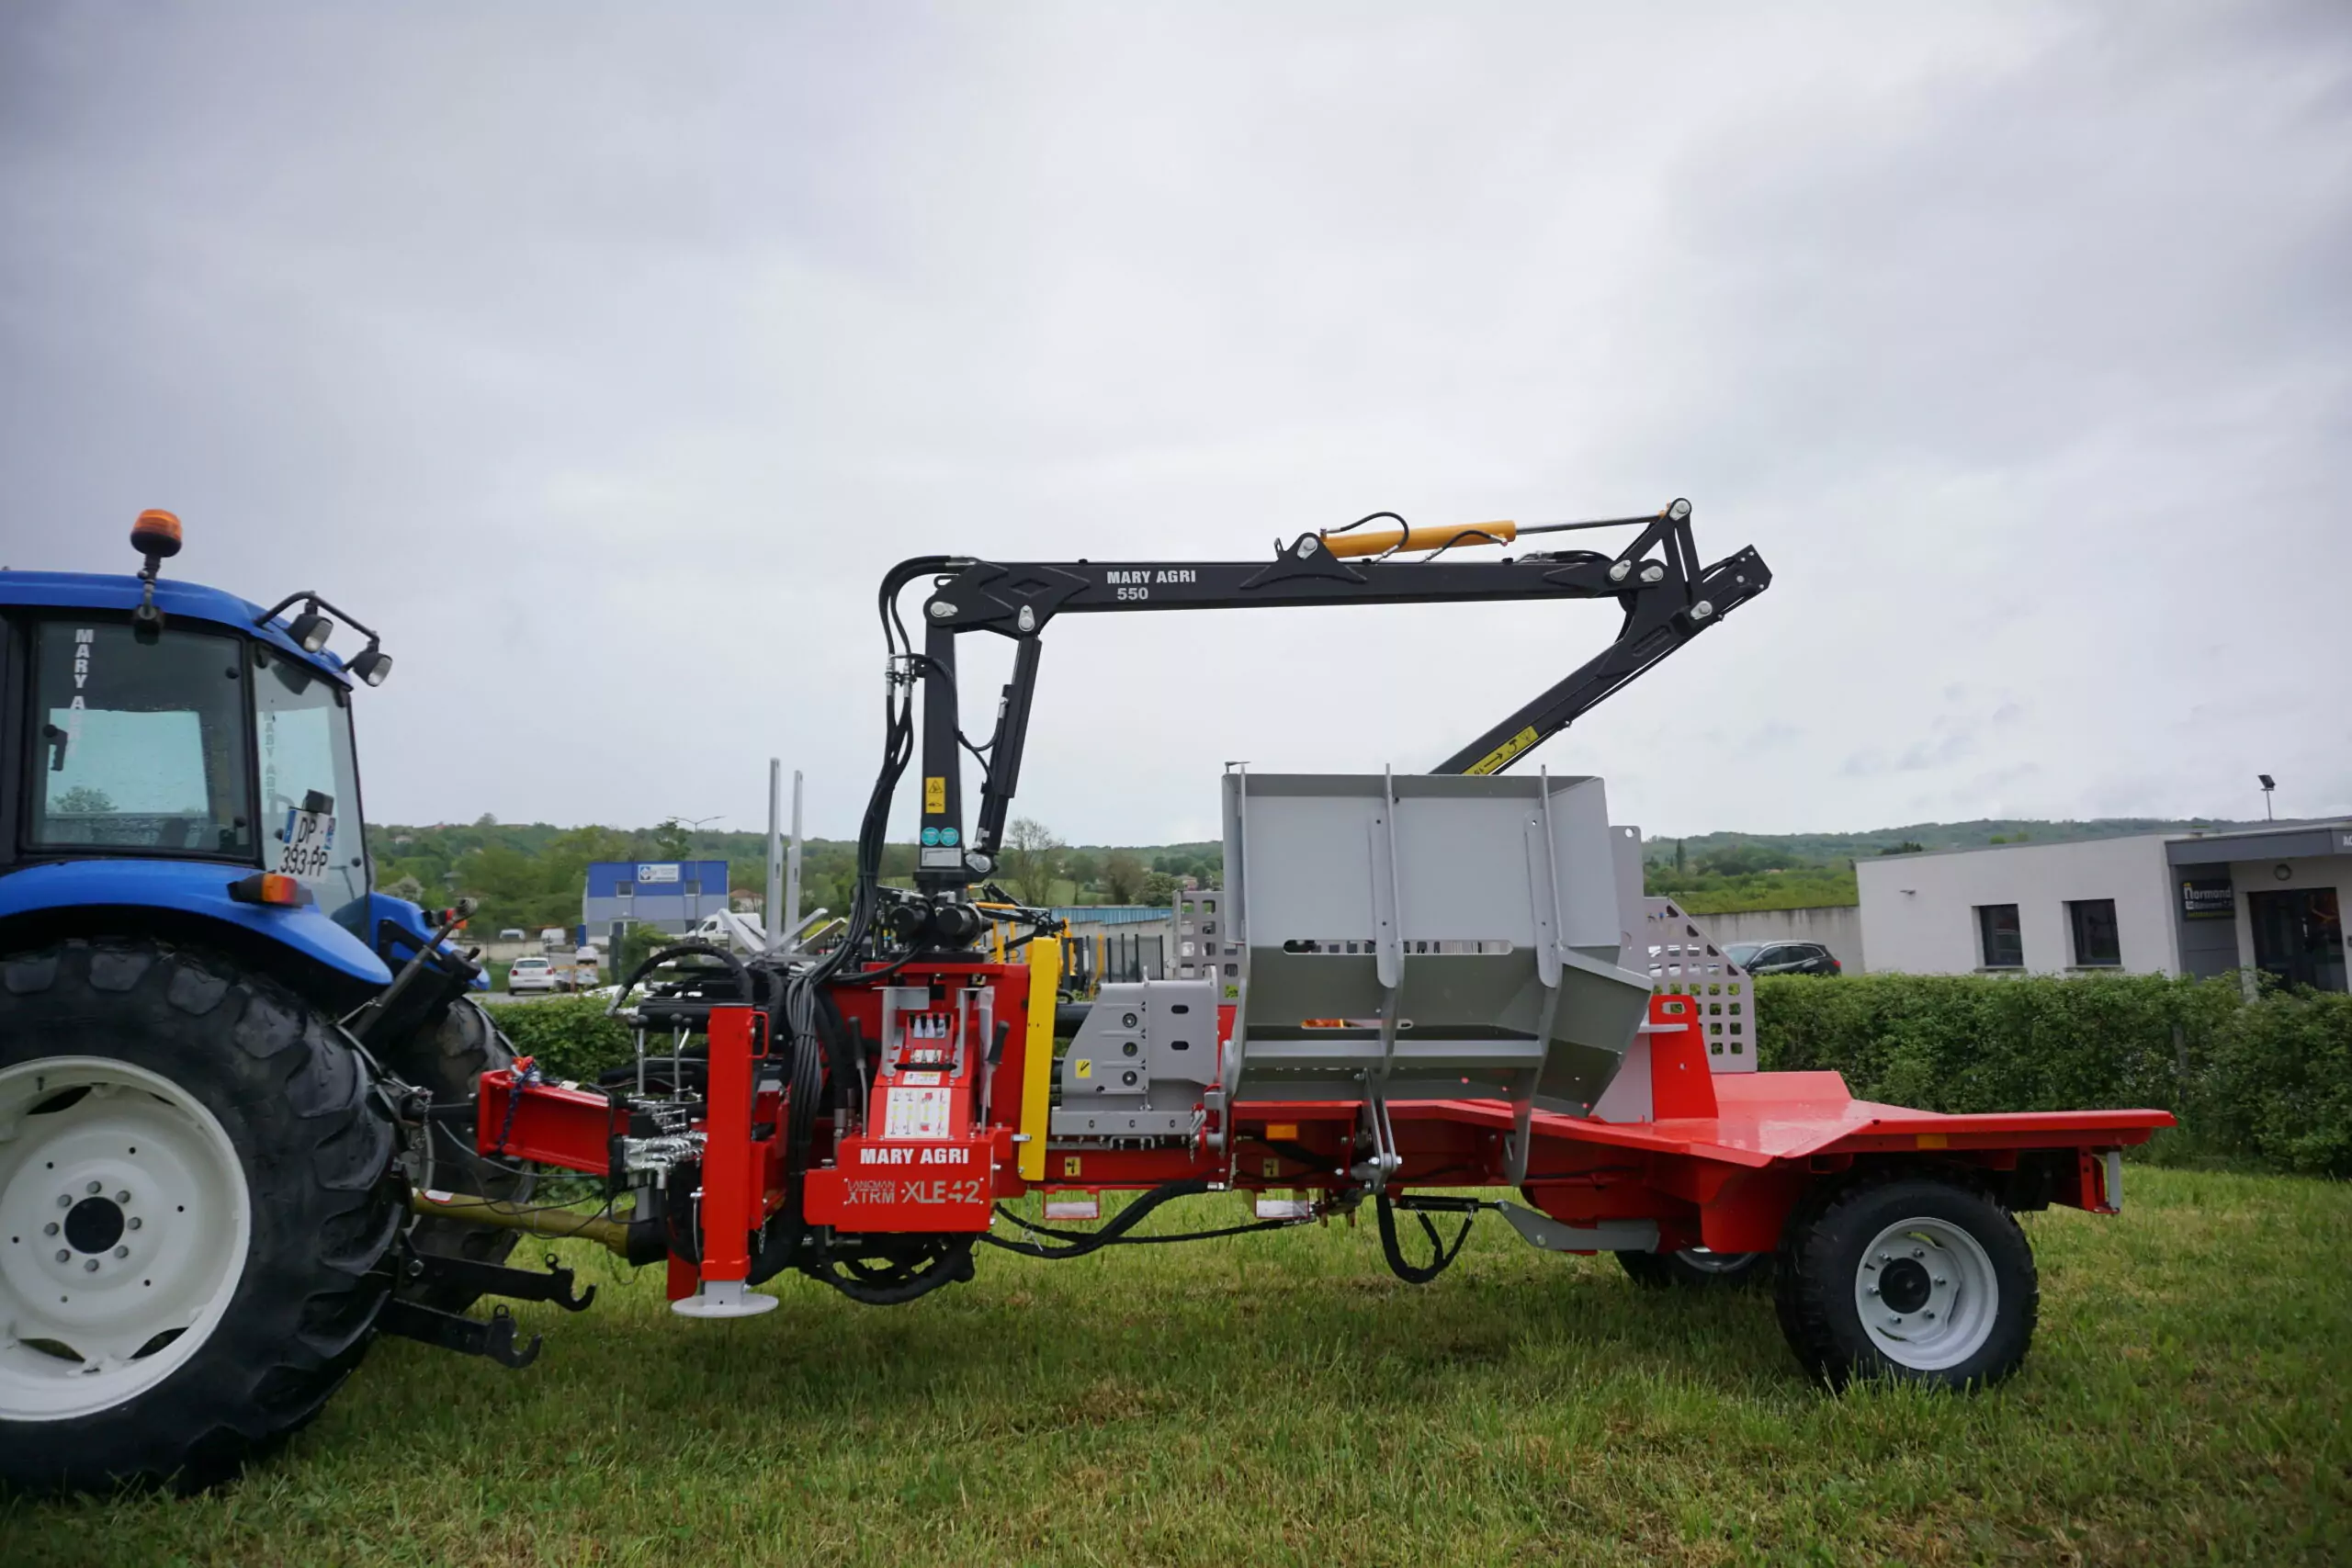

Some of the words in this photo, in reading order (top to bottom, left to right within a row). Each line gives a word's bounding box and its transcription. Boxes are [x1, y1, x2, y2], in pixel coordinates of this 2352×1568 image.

[1106, 570, 1151, 584] MARY
[1156, 570, 1196, 583] AGRI
[1116, 587, 1148, 601] 550
[74, 628, 94, 689] MARY
[860, 1148, 914, 1165] MARY
[920, 1148, 969, 1165] AGRI
